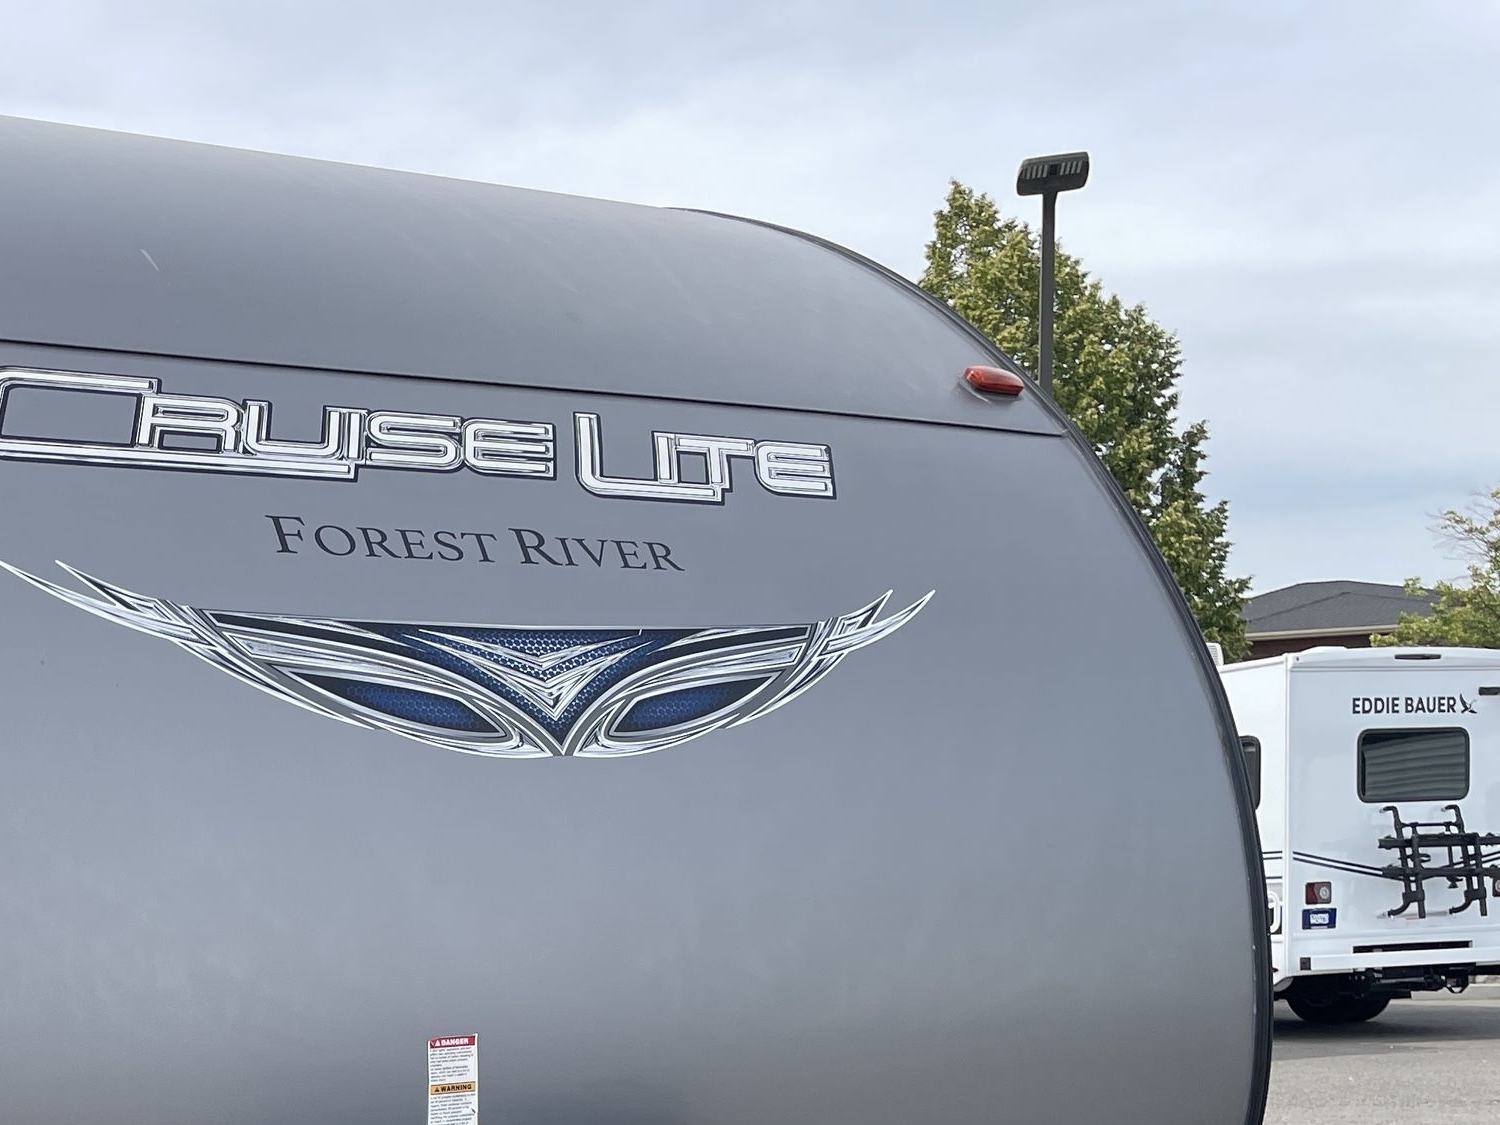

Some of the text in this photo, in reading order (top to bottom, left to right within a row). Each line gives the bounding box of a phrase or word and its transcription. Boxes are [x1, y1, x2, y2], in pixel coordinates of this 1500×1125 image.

[573, 411, 837, 505] LITE
[265, 515, 686, 572] FOREST RIVER
[1352, 696, 1457, 714] EDDIE BAUER
[440, 1037, 469, 1046] DANGER
[440, 1083, 472, 1093] WARNING
